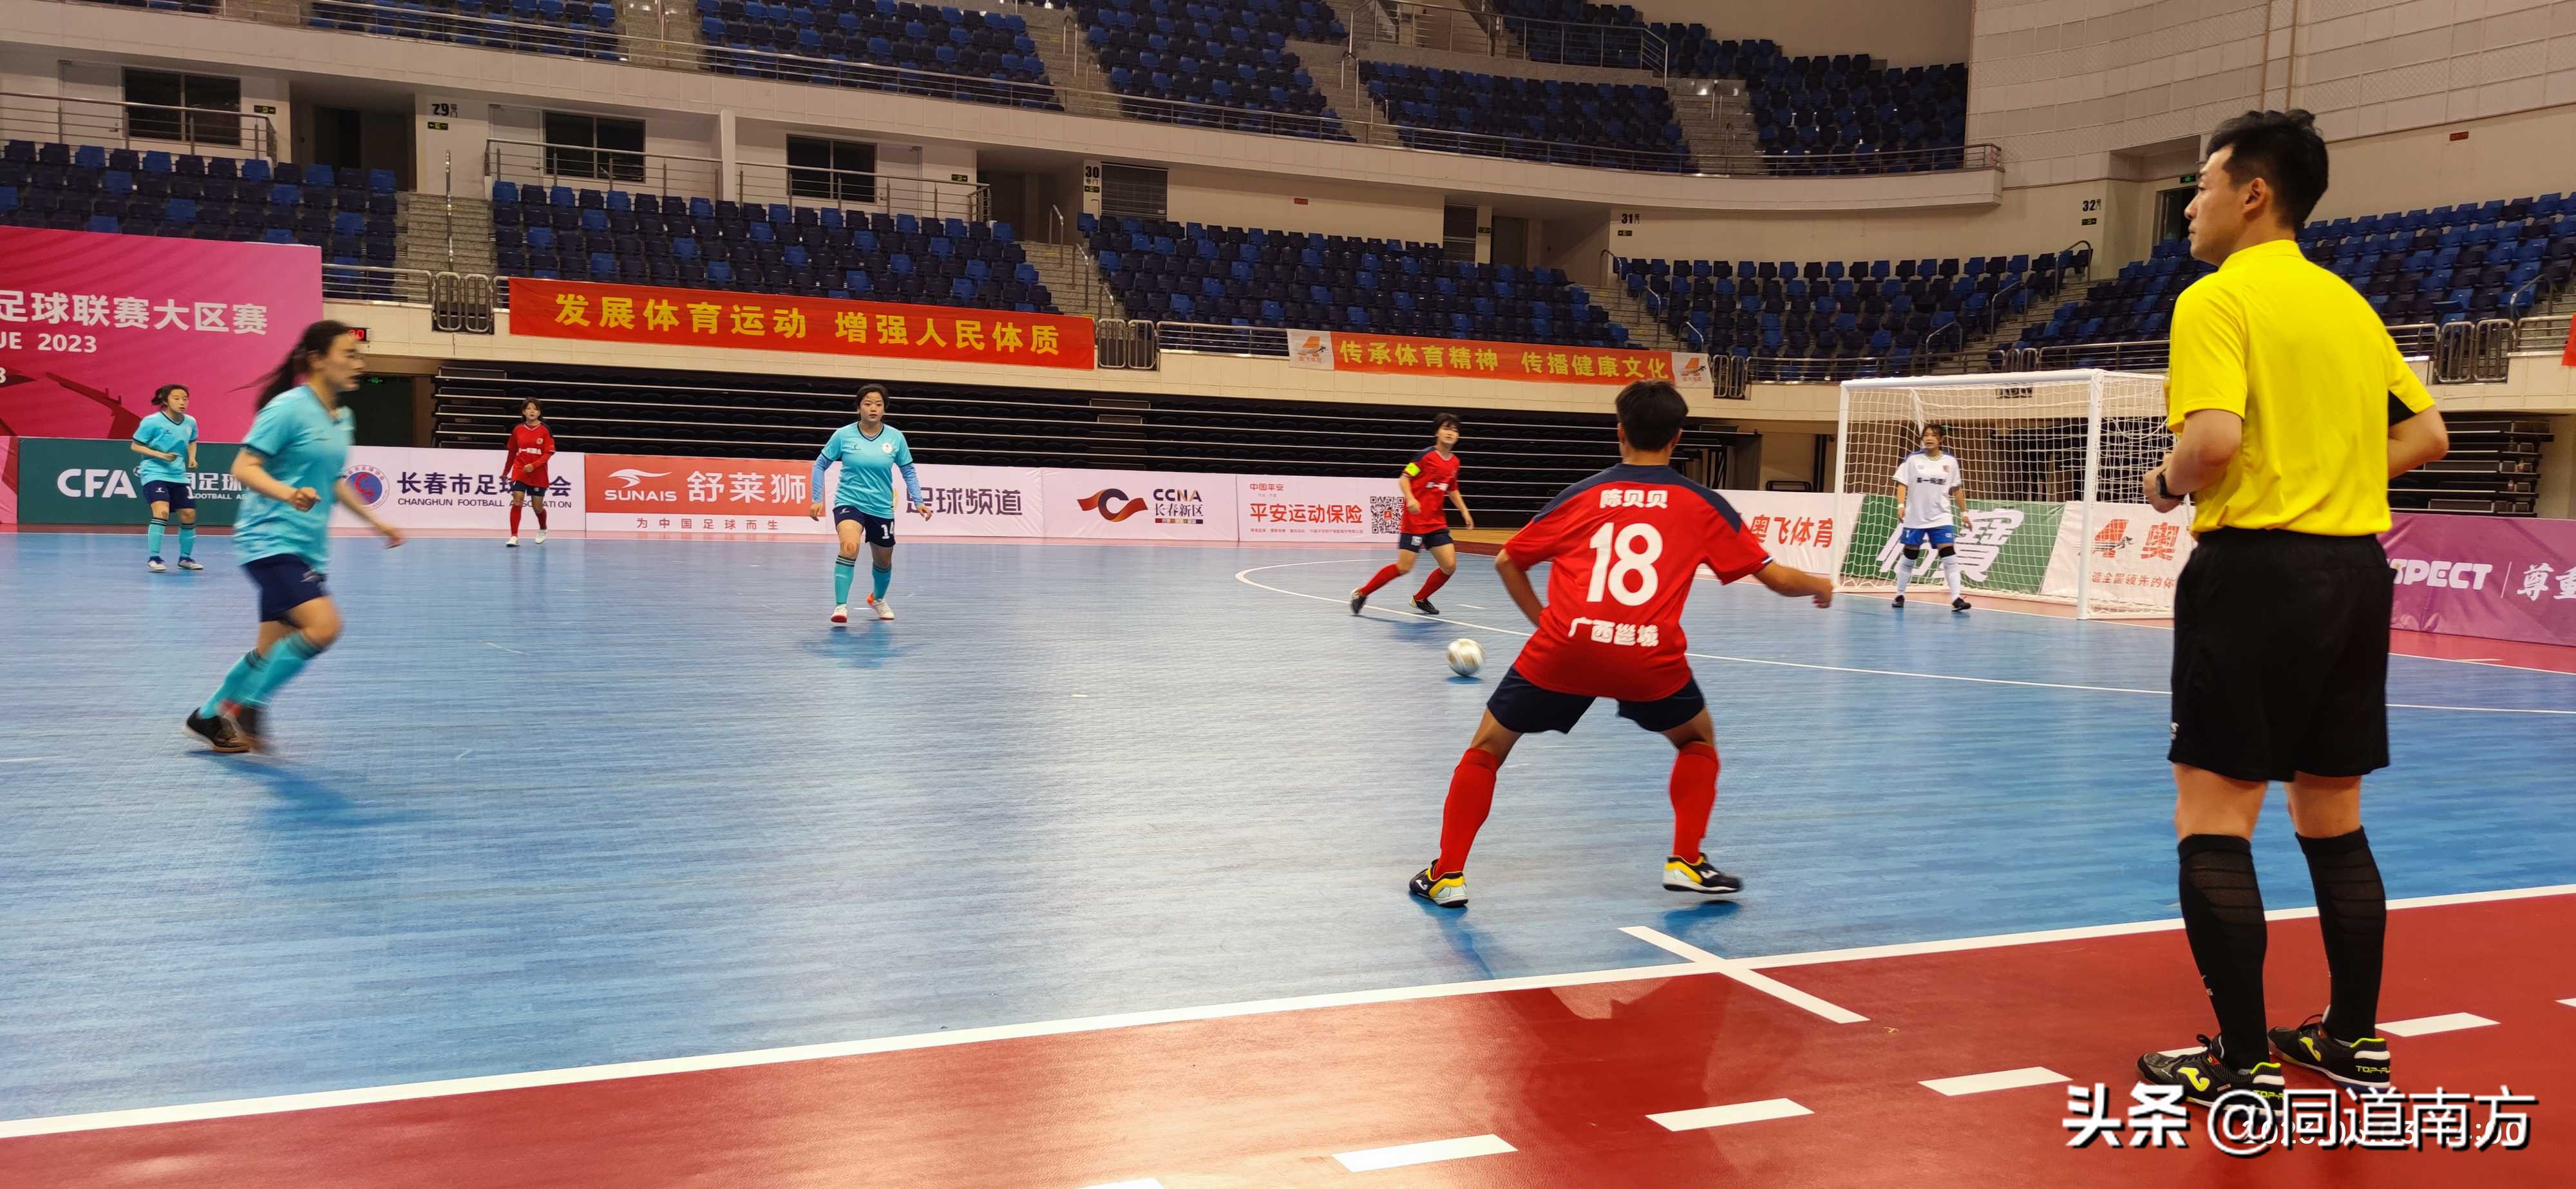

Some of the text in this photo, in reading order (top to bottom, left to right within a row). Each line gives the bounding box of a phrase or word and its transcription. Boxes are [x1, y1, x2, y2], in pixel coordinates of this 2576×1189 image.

[431, 103, 450, 116] 29
[1085, 166, 1099, 178] 30
[2082, 200, 2096, 211] 32
[1622, 213, 1633, 224] 31
[0, 289, 268, 336] 足球联赛大区赛
[555, 293, 1059, 356] 发展体育运动 增强人民体质
[37, 333, 97, 352] 2023
[1340, 340, 1669, 379] 传承体育精神 传播健康文化
[57, 468, 137, 499] CFA
[184, 472, 242, 491] 足球
[397, 471, 572, 497] 长春市足球会
[687, 470, 806, 504] 舒莱狮
[1249, 483, 1284, 491] 中国平安
[397, 497, 453, 506] CHANGHUN
[457, 499, 504, 508] FOOTBALL
[605, 490, 677, 502] SUNAIS
[906, 487, 1023, 515] 足球频道
[1153, 488, 1202, 502] CCNA
[1599, 488, 1668, 509] 陈贝贝
[1155, 502, 1204, 517] 长春新区
[1249, 503, 1363, 524] 平安运动保险
[636, 517, 779, 530] 为中国足球而生
[1750, 514, 1833, 548] 奥飞体育
[1586, 522, 1663, 606] 18
[2384, 558, 2493, 590] SPECT
